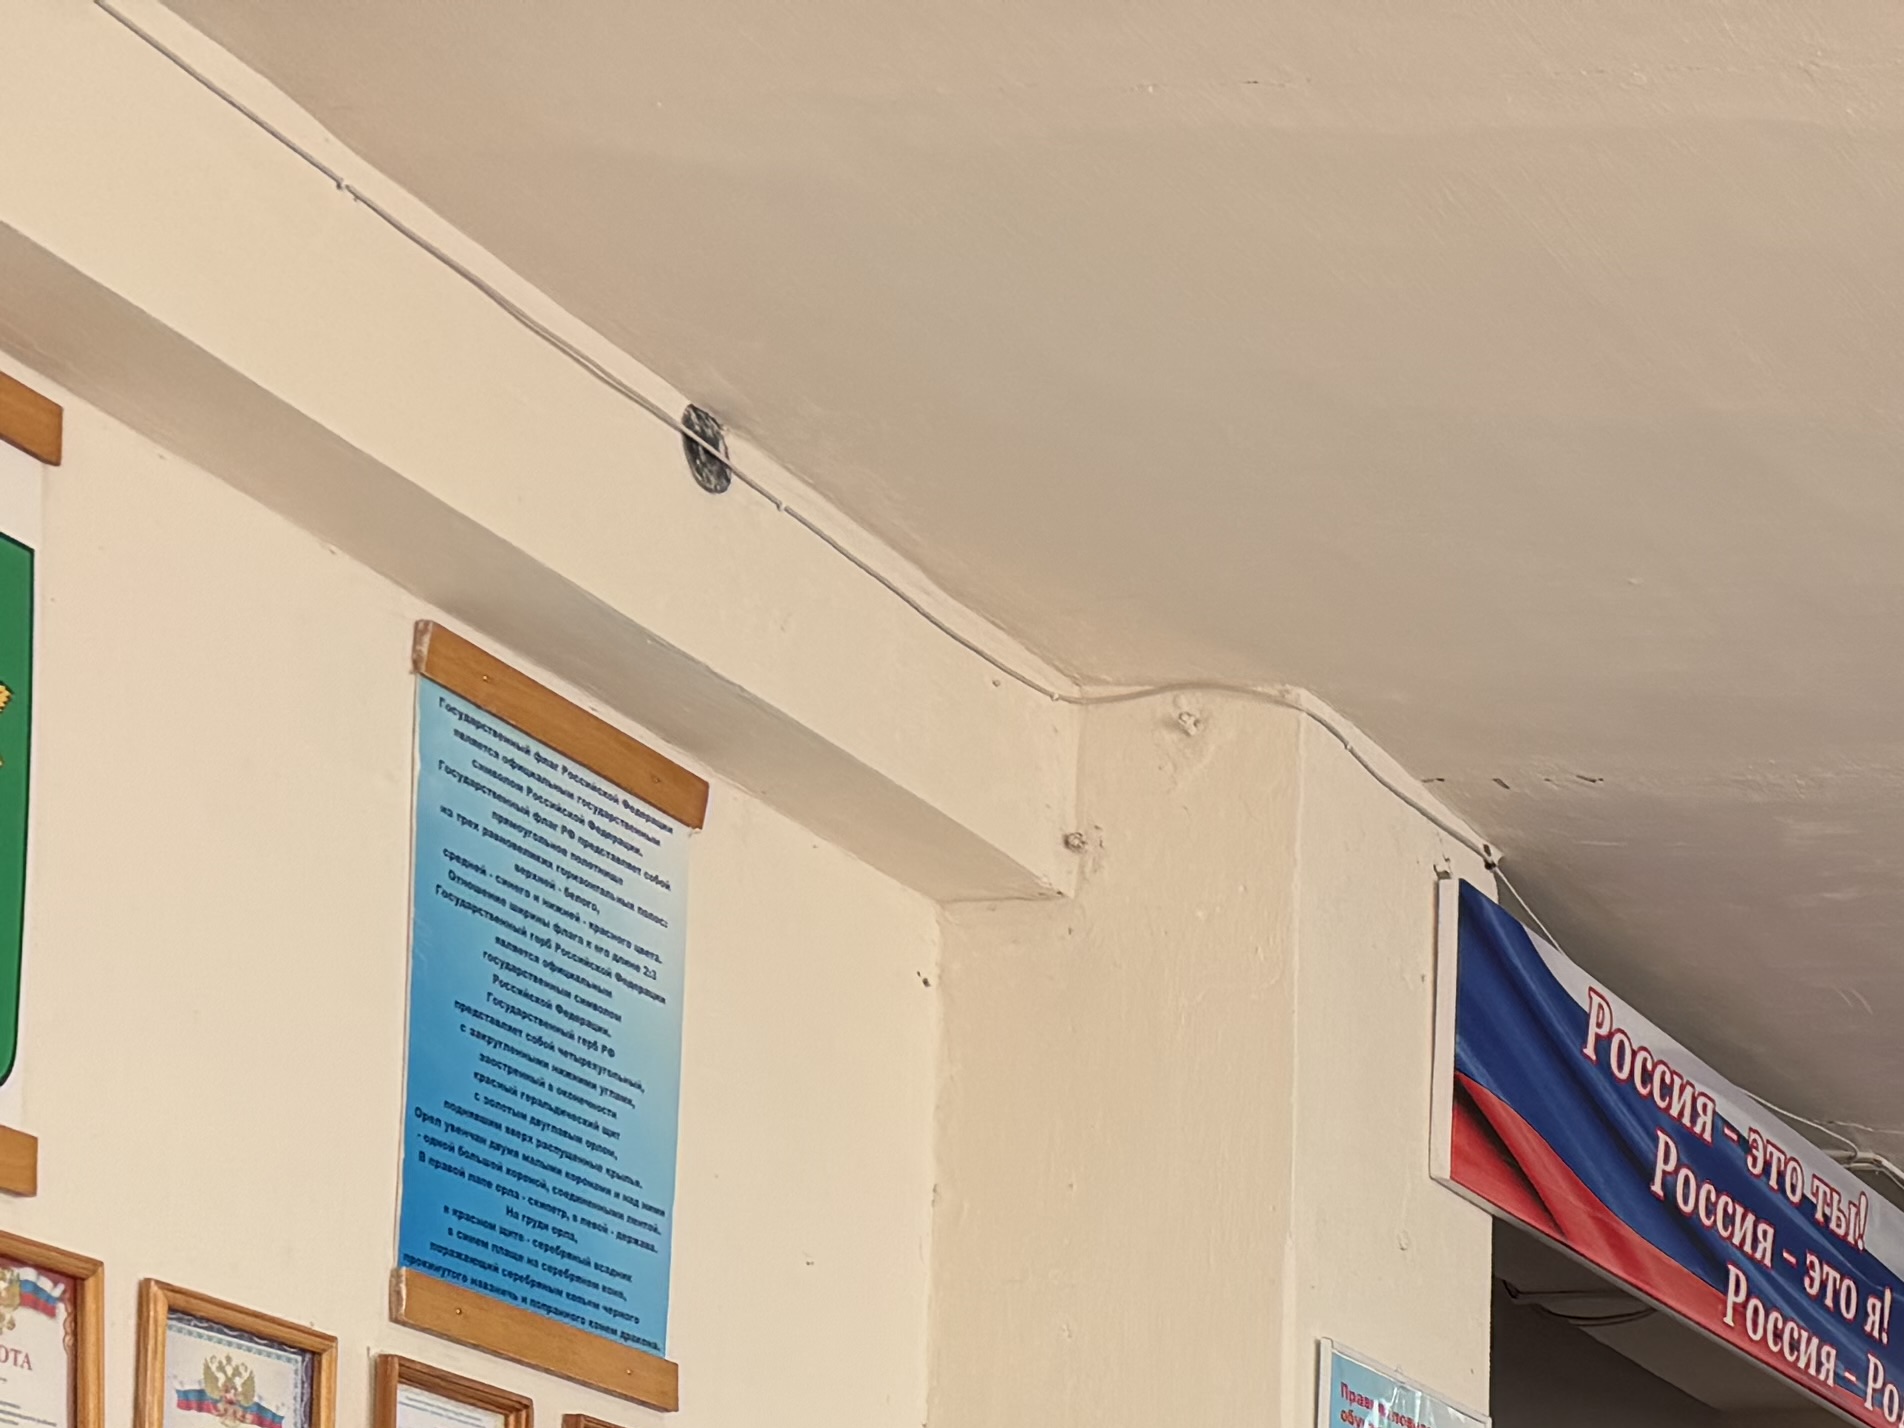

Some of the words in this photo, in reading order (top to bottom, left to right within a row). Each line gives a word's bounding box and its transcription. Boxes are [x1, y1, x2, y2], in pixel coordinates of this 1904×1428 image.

[438, 696, 531, 756] Государственный
[533, 750, 559, 771] флаг
[561, 764, 619, 805] Российской
[622, 799, 673, 834] Федерации
[526, 785, 585, 826] Российской
[438, 759, 530, 817] Государственный
[532, 812, 559, 831] флаг
[561, 824, 575, 840] РФ
[577, 836, 642, 875] представляет
[643, 871, 671, 891] собой
[443, 848, 487, 876] средней
[495, 875, 531, 898] синего
[589, 921, 632, 949] красного
[448, 869, 507, 907] Отношение
[509, 902, 550, 928] ширины
[553, 922, 584, 945] флага
[586, 940, 592, 949] к
[594, 944, 610, 958] его
[436, 884, 527, 937] Государственный
[530, 932, 552, 949] герб
[554, 942, 612, 978] Российской
[615, 972, 666, 1004] Федерации
[454, 1000, 523, 1037] представляет
[526, 1032, 555, 1052] собой
[486, 991, 575, 1040] Государственный
[577, 1035, 598, 1051] герб
[601, 1044, 615, 1058] РФ
[492, 973, 552, 1010] Российской
[473, 1071, 518, 1097] красный
[520, 1091, 600, 1131] геральдический
[602, 1126, 620, 1140] щит
[479, 1053, 546, 1088] заостренный
[548, 1082, 553, 1092] в
[414, 1106, 442, 1127] Орел
[444, 1121, 487, 1145] увенчан
[489, 1140, 519, 1158] двумя
[522, 1153, 562, 1176] малыми
[565, 1171, 612, 1196] коронами
[614, 1191, 620, 1199] и
[622, 1194, 639, 1208] над
[483, 1096, 527, 1121] золотым
[529, 1116, 583, 1144] двуглавым
[1582, 985, 1715, 1145] Россия
[1746, 1126, 1806, 1206] это
[1810, 1174, 1869, 1252] ты!
[452, 1208, 496, 1231] красном
[531, 1238, 592, 1267] серебряный
[593, 1261, 632, 1283] всадник
[506, 1204, 519, 1220] На
[521, 1214, 549, 1231] груди
[1650, 1127, 1774, 1267] Россия
[1803, 1249, 1858, 1321] это
[1864, 1286, 1892, 1345] я!
[1723, 1263, 1838, 1388] Россия
